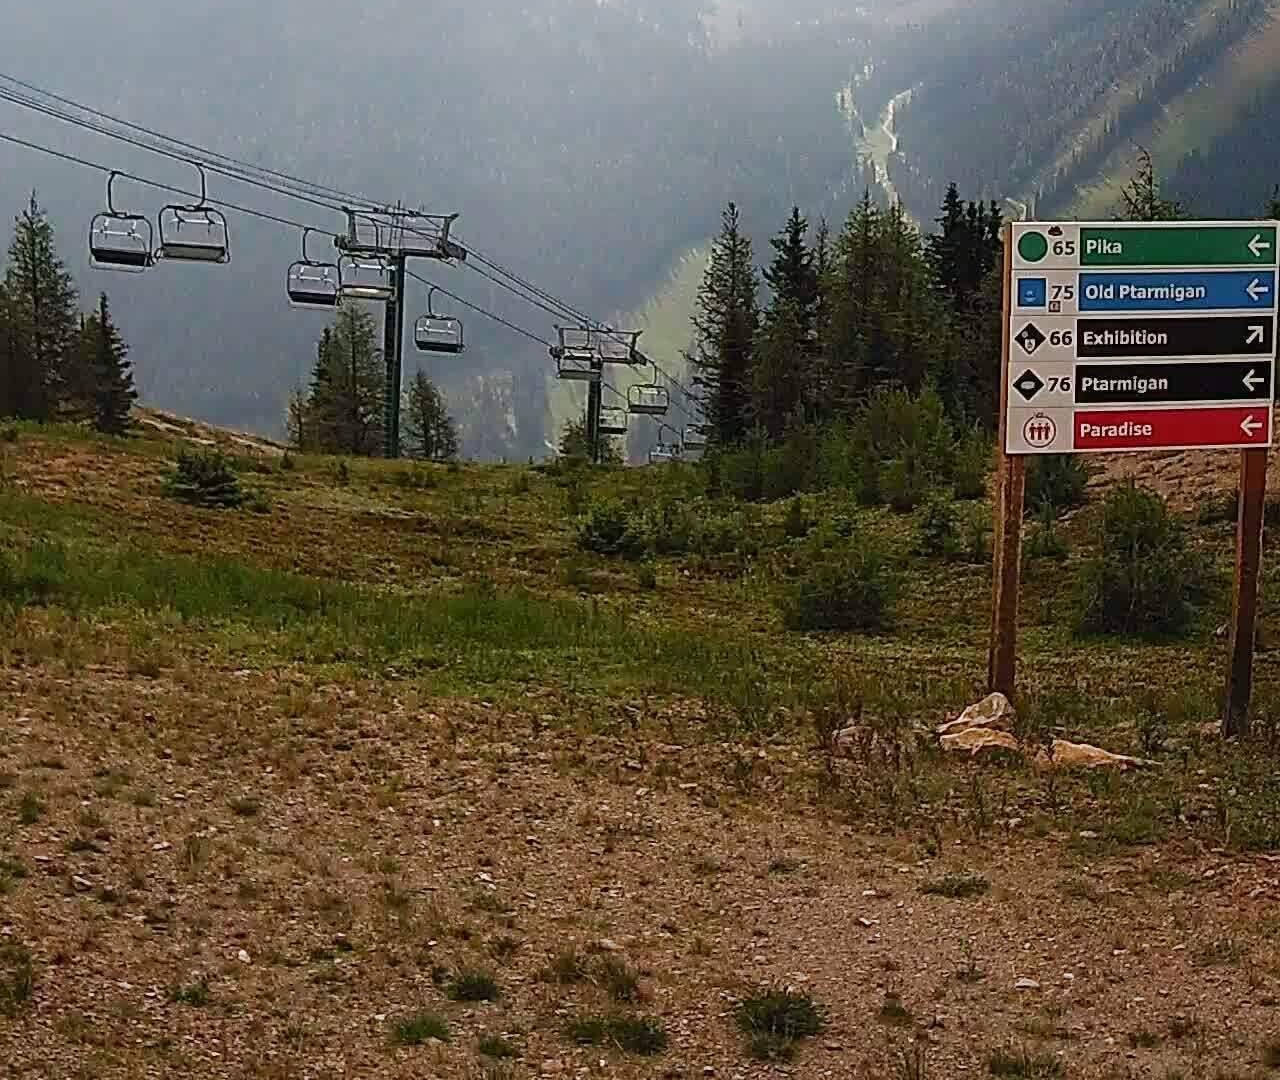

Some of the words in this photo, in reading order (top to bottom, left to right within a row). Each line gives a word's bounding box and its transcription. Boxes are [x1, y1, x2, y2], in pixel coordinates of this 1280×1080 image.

[1052, 241, 1075, 256] 65
[1086, 239, 1122, 254] Pika
[1051, 285, 1074, 300] 75
[1085, 284, 1113, 299] Old
[1119, 284, 1205, 302] Ptarmigan
[1050, 330, 1073, 346] 66
[1083, 330, 1168, 345] Exhibition
[1048, 377, 1071, 392] 76
[1081, 376, 1168, 394] Ptarmigan
[1080, 422, 1152, 438] Paradise
